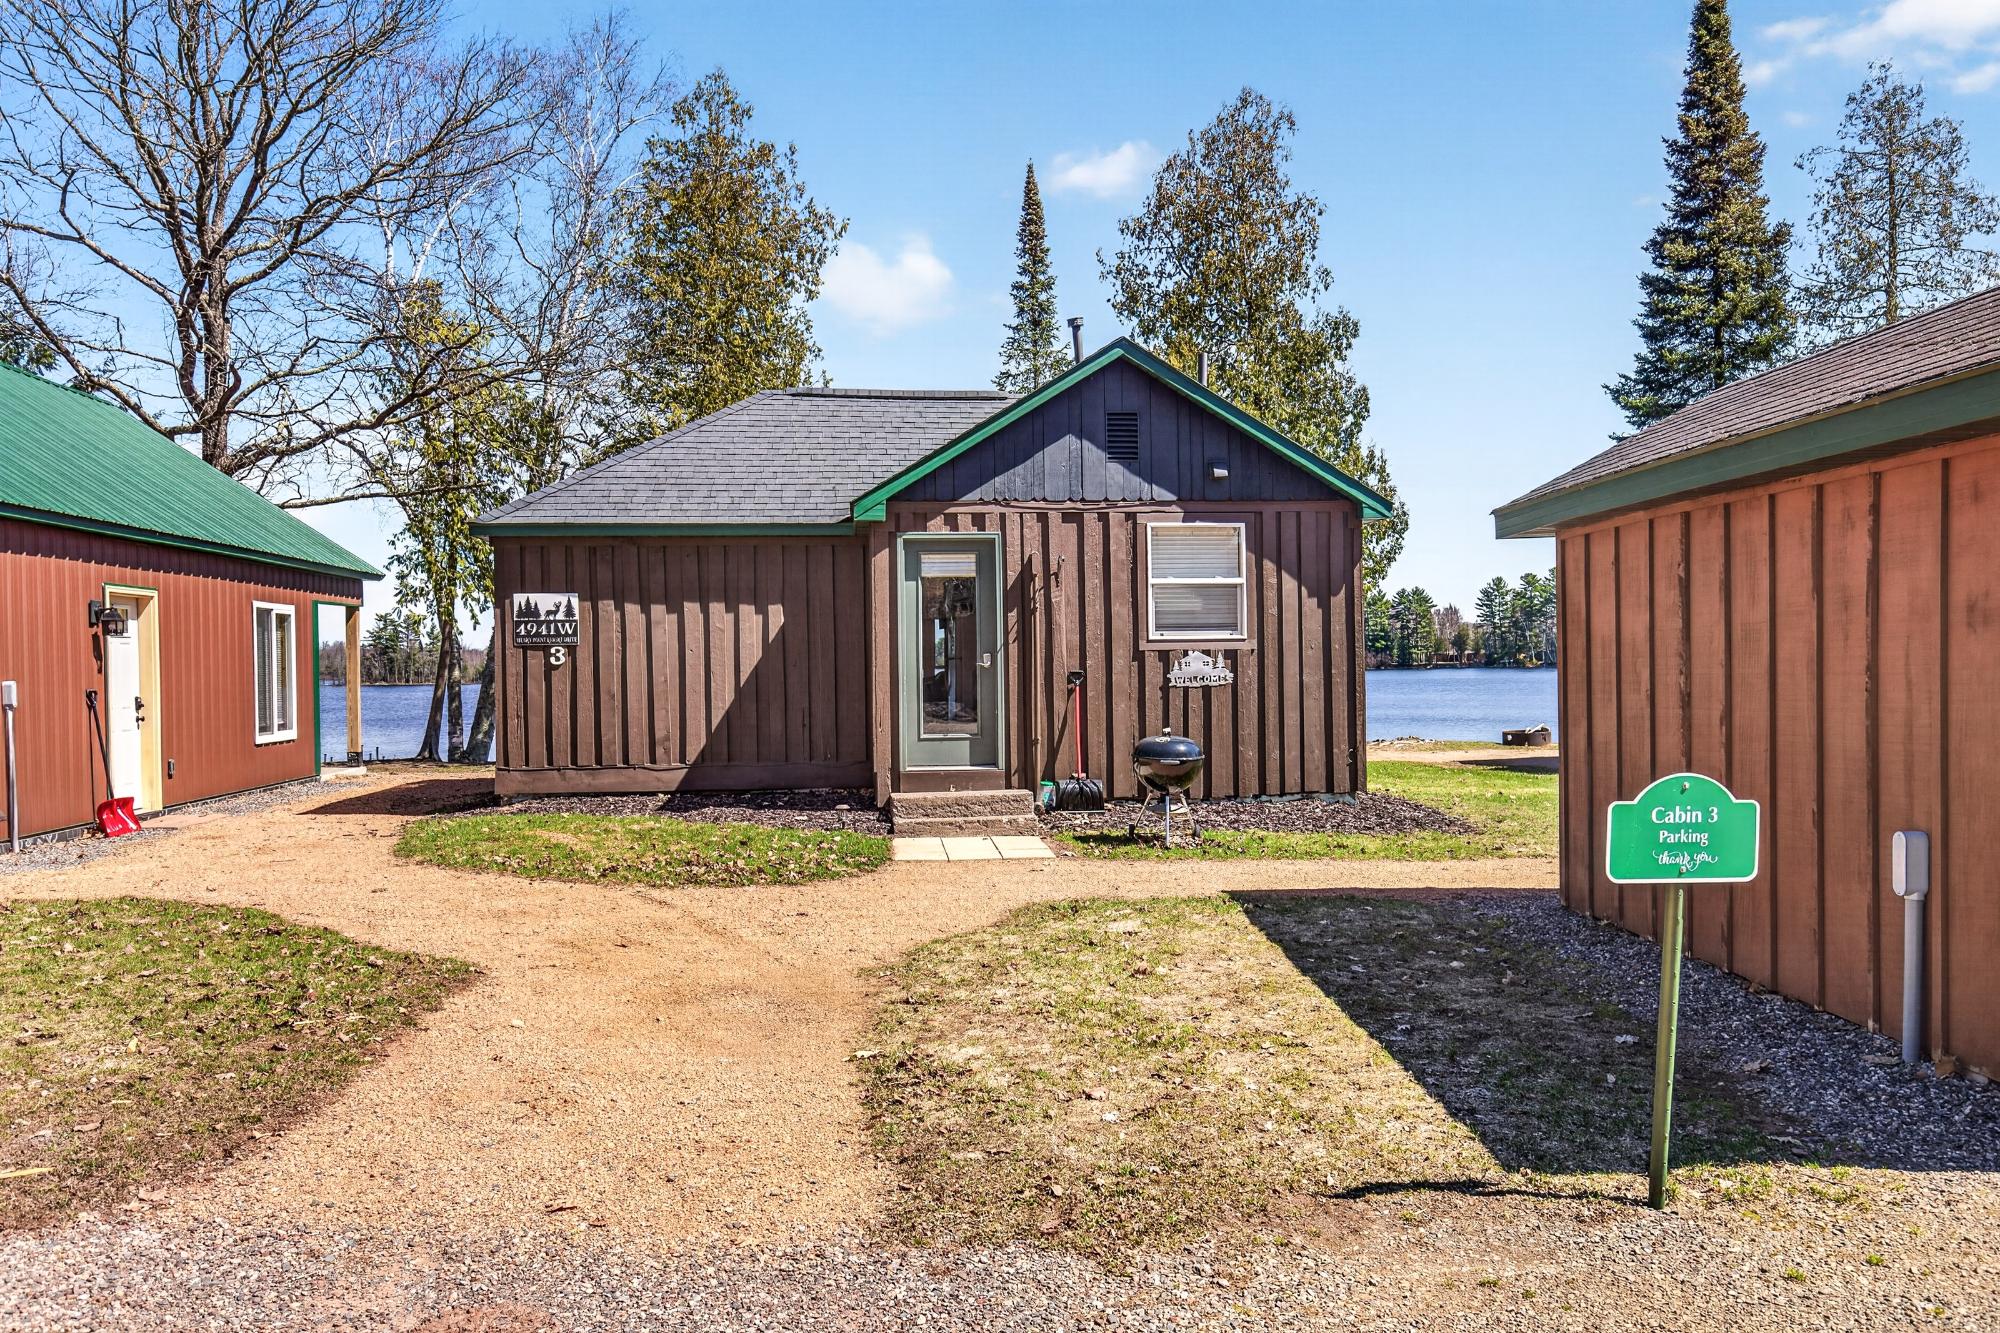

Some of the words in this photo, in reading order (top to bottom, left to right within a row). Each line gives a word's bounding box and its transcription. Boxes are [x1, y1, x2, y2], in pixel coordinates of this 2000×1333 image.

[516, 622, 577, 636] 4941W
[549, 646, 566, 665] 3
[1174, 674, 1228, 684] WELCOME
[1651, 805, 1702, 824] Cabin
[1707, 806, 1718, 823] 3
[1659, 829, 1708, 847] Parking
[1653, 850, 1692, 868] thank
[1688, 851, 1718, 871] you
